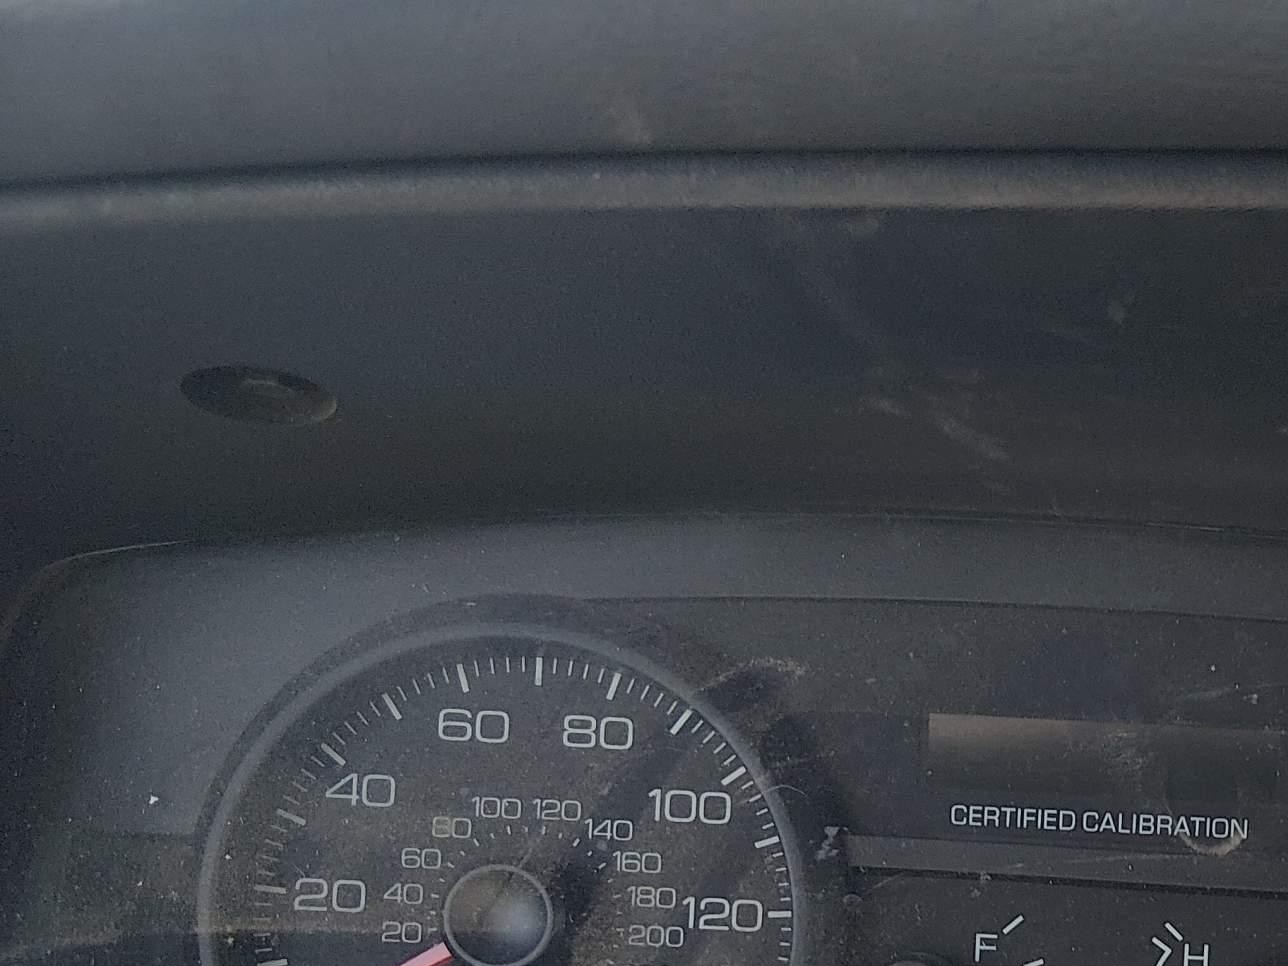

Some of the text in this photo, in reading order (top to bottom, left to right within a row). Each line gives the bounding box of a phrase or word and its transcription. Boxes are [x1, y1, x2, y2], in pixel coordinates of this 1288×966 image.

[438, 709, 510, 743] 60
[563, 715, 634, 750] 80
[326, 773, 396, 808] 40
[471, 796, 522, 819] 100
[533, 799, 582, 821] 120
[648, 788, 732, 825] 100
[433, 817, 472, 838] 80
[584, 819, 633, 842] 140
[950, 805, 1249, 840] CERTIFIED CALIBRATION
[401, 848, 442, 870] 60
[613, 850, 662, 874] 160
[294, 879, 366, 913] 20
[384, 884, 424, 905] 40
[627, 886, 677, 909] 180
[683, 897, 763, 932] 120
[382, 922, 422, 944] 20
[628, 926, 685, 949] 200
[975, 933, 998, 962] F
